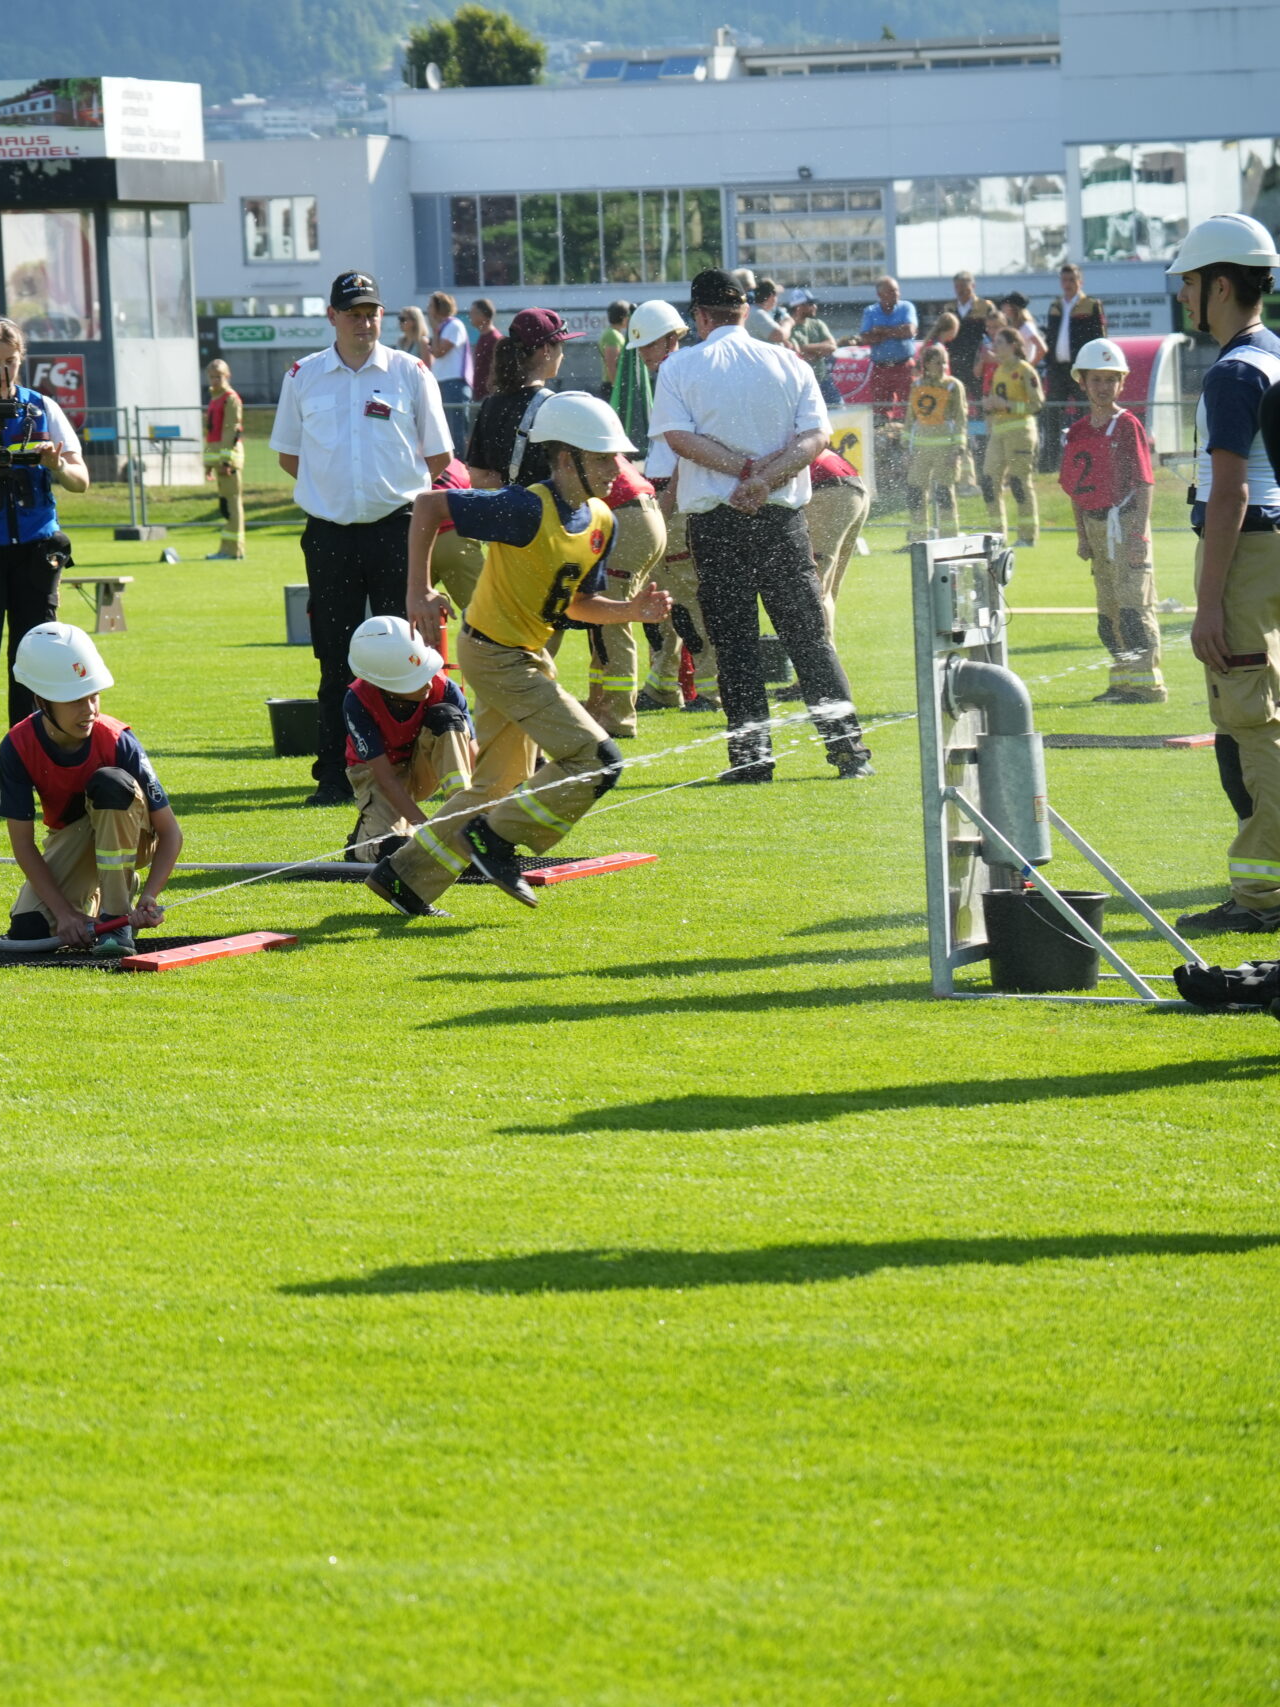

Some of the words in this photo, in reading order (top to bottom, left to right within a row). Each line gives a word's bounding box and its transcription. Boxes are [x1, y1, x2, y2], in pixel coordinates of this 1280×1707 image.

[223, 326, 273, 340] sport
[917, 394, 937, 416] 9
[1074, 451, 1096, 494] 2
[542, 563, 582, 622] 6
